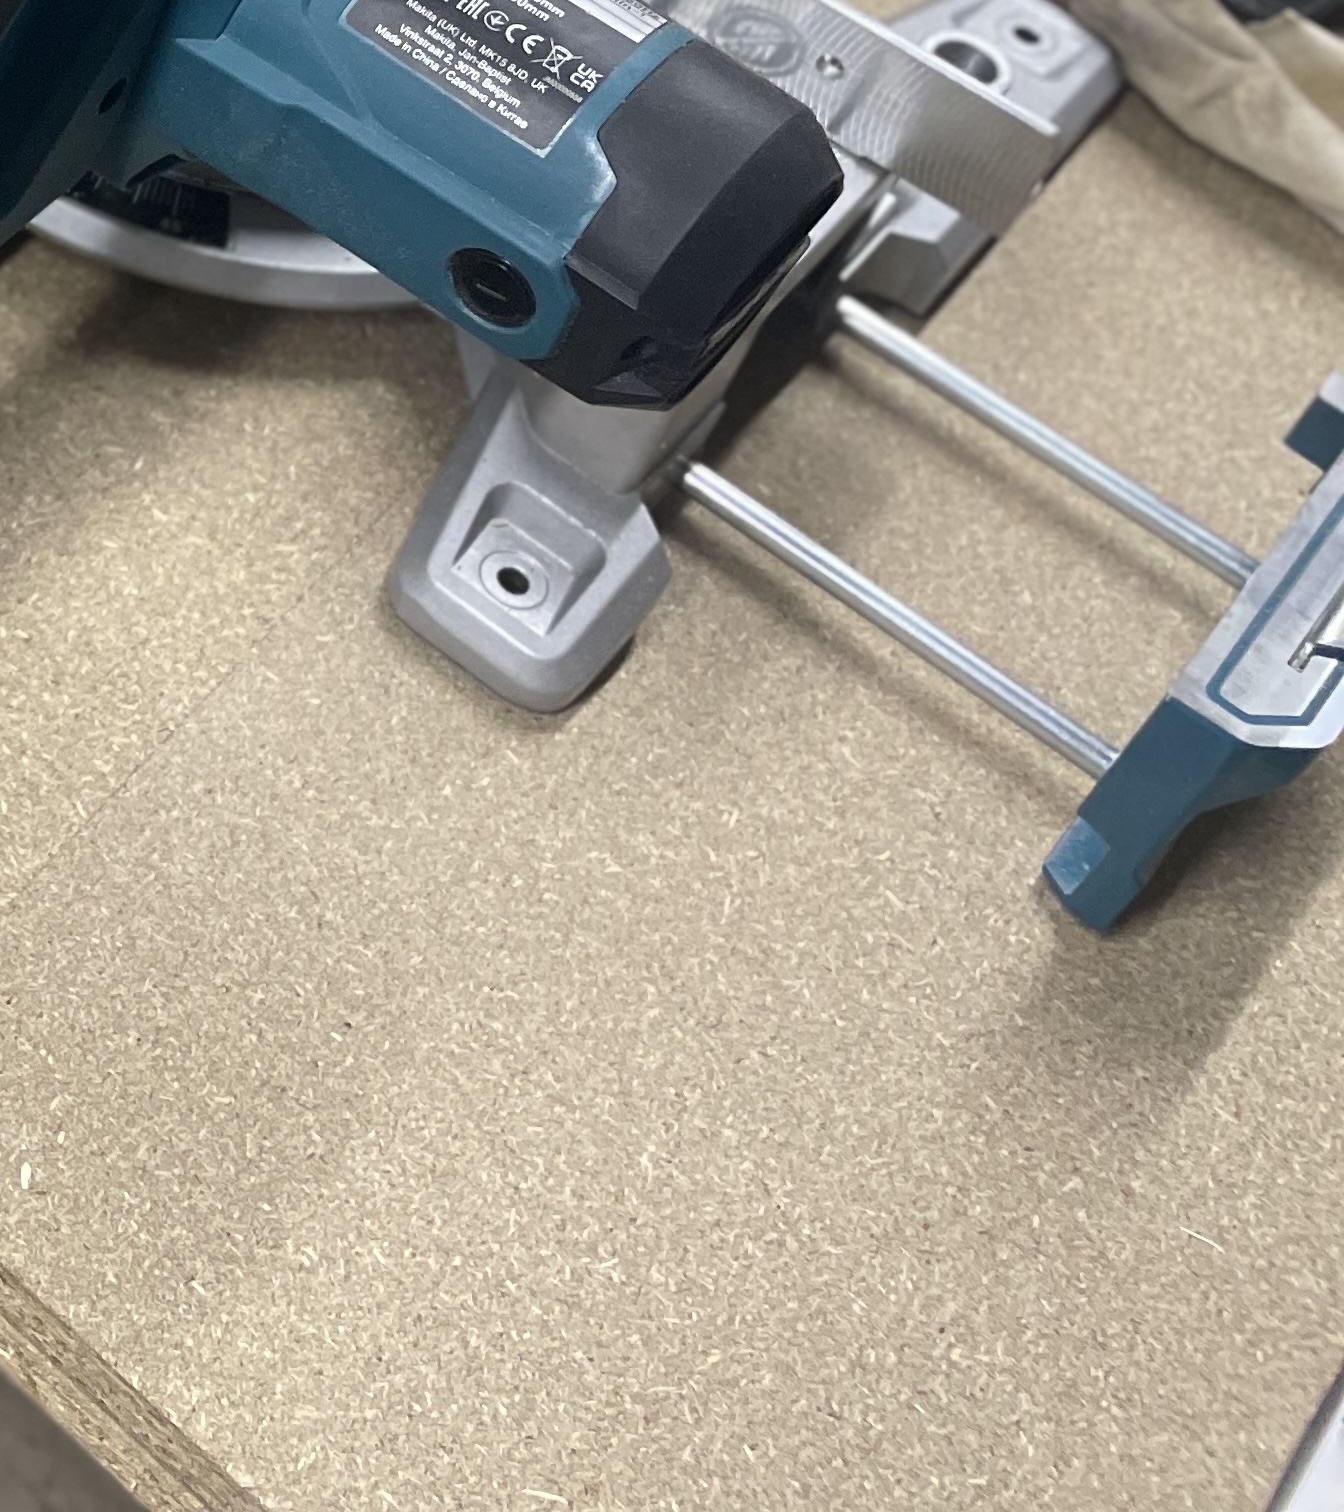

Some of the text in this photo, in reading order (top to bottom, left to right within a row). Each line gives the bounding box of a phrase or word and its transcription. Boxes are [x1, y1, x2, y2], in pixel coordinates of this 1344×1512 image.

[374, 23, 403, 47] Made
[400, 41, 412, 54] in
[411, 48, 440, 72] China
[399, 22, 446, 59] Vinkstraat
[442, 53, 454, 67] 2,
[481, 77, 521, 108] Belgium
[436, 18, 460, 38] (UK)
[478, 44, 509, 67] MK15
[530, 77, 549, 94] UK
[457, 48, 512, 86] Jan-Baptist
